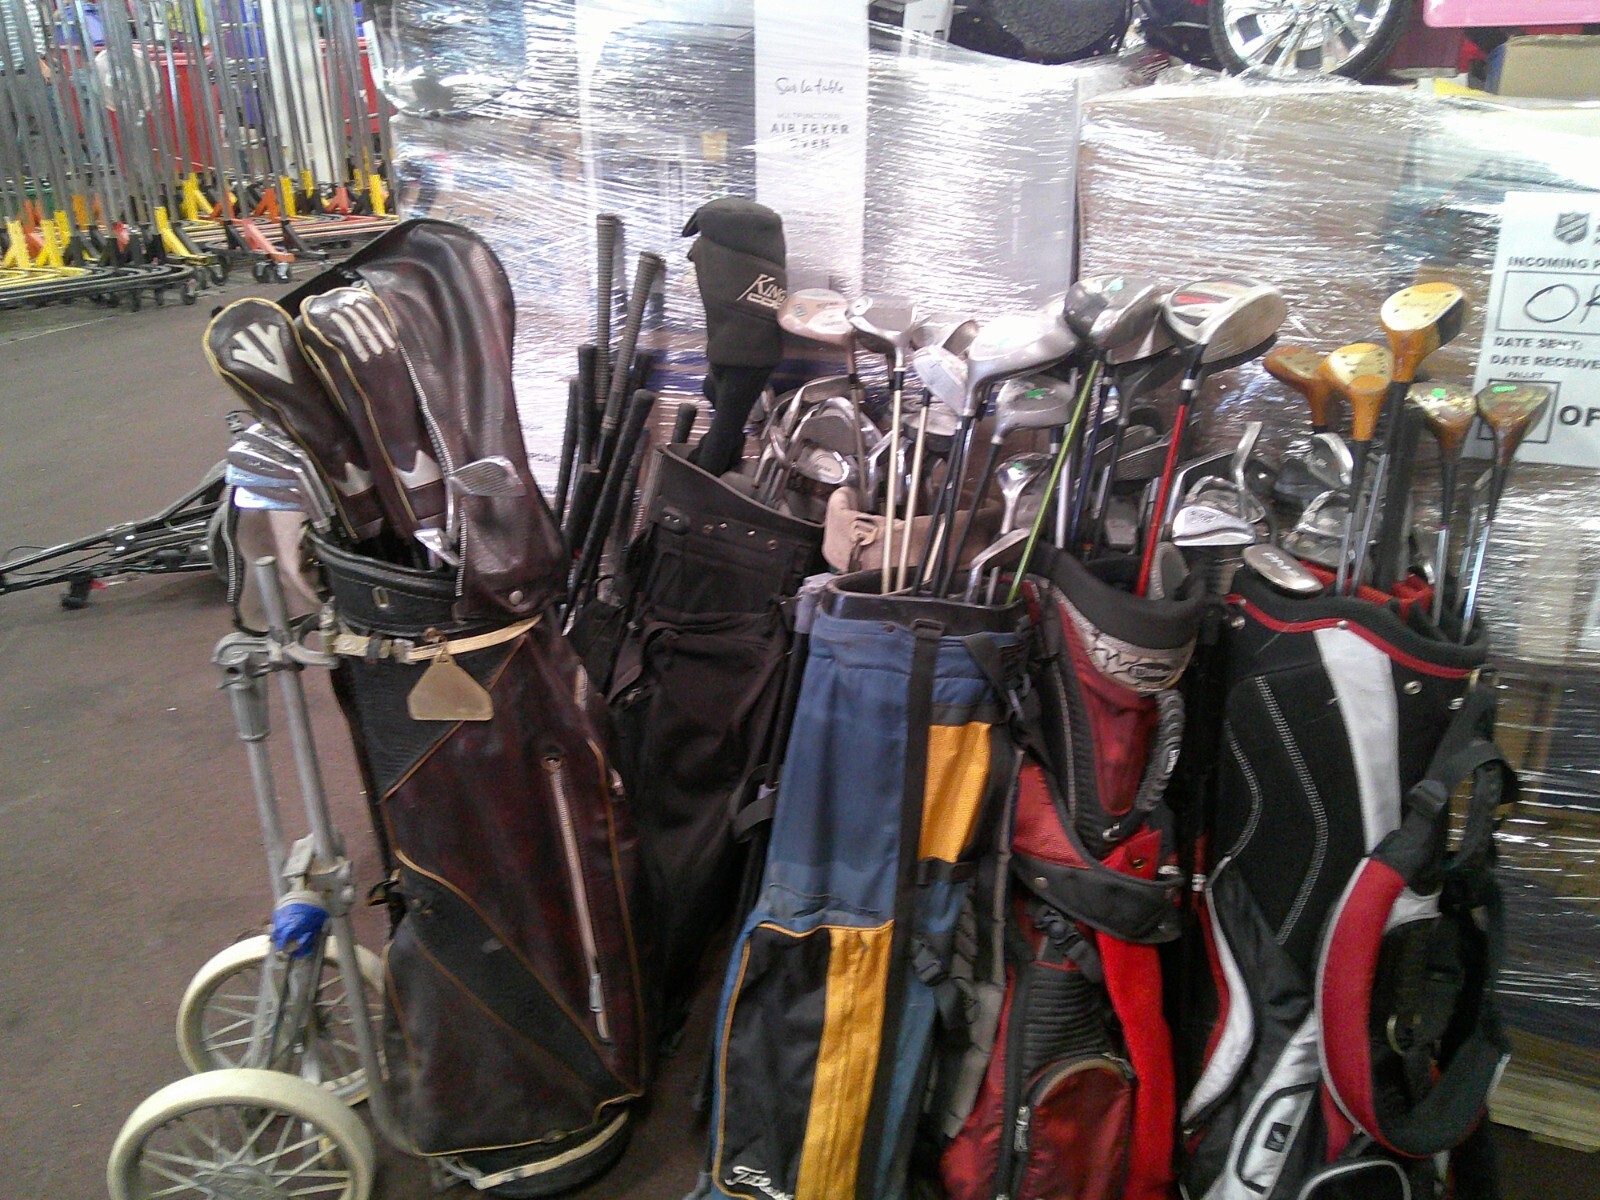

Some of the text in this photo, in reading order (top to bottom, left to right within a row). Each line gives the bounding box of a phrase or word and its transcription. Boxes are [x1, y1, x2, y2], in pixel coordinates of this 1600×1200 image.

[770, 123, 849, 134] AIR FRYER
[1507, 255, 1589, 269] INCOMING
[1493, 336, 1534, 349] DATE
[1489, 354, 1531, 365] DATE
[1505, 371, 1546, 379] PALLET
